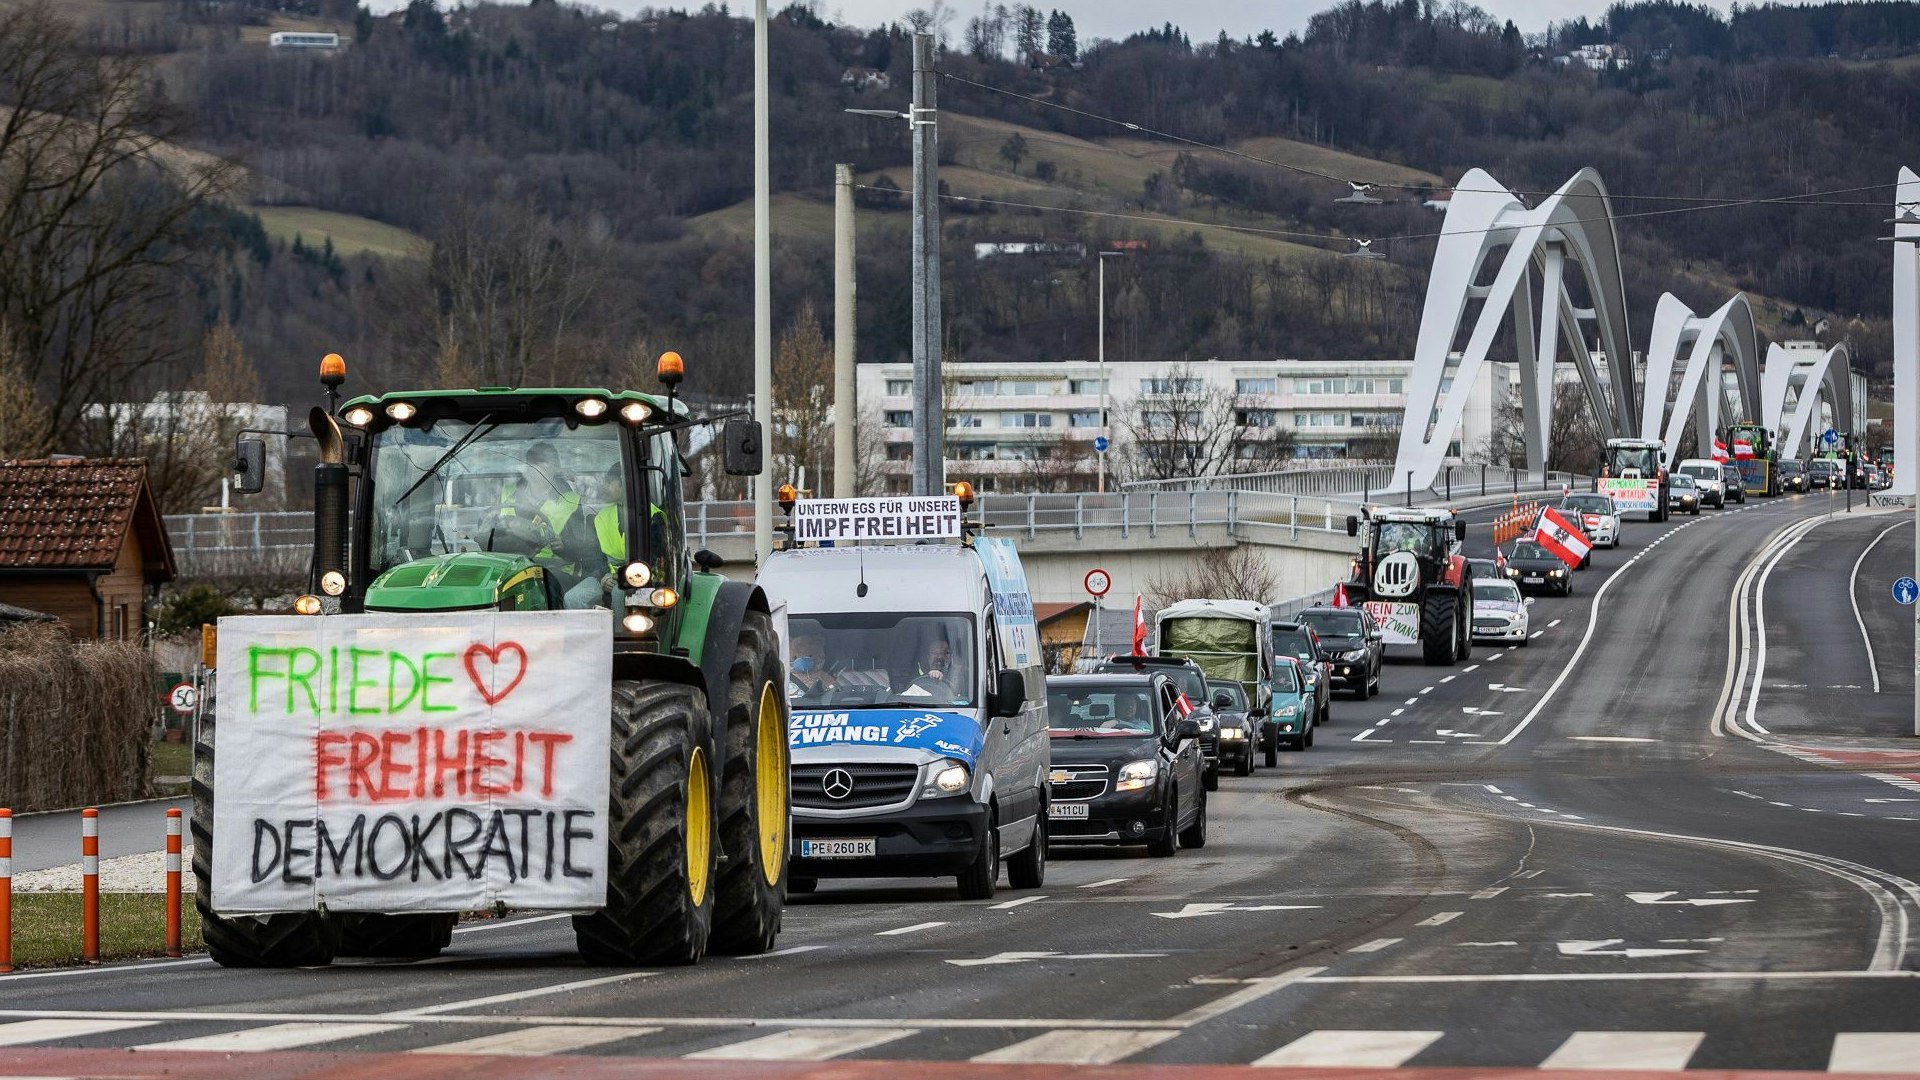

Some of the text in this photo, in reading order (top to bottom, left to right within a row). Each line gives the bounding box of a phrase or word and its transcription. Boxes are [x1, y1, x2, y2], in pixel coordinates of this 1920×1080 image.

[879, 500, 903, 513] FÜR
[908, 500, 957, 512] UNSERE
[1366, 603, 1392, 615] NEIN
[246, 645, 458, 715] FRIEDE
[315, 727, 574, 801] FREIHEIT
[251, 808, 596, 887] DEMOKRATIE
[811, 843, 826, 854] PE
[833, 842, 855, 854] 260
[857, 842, 872, 854] BK
